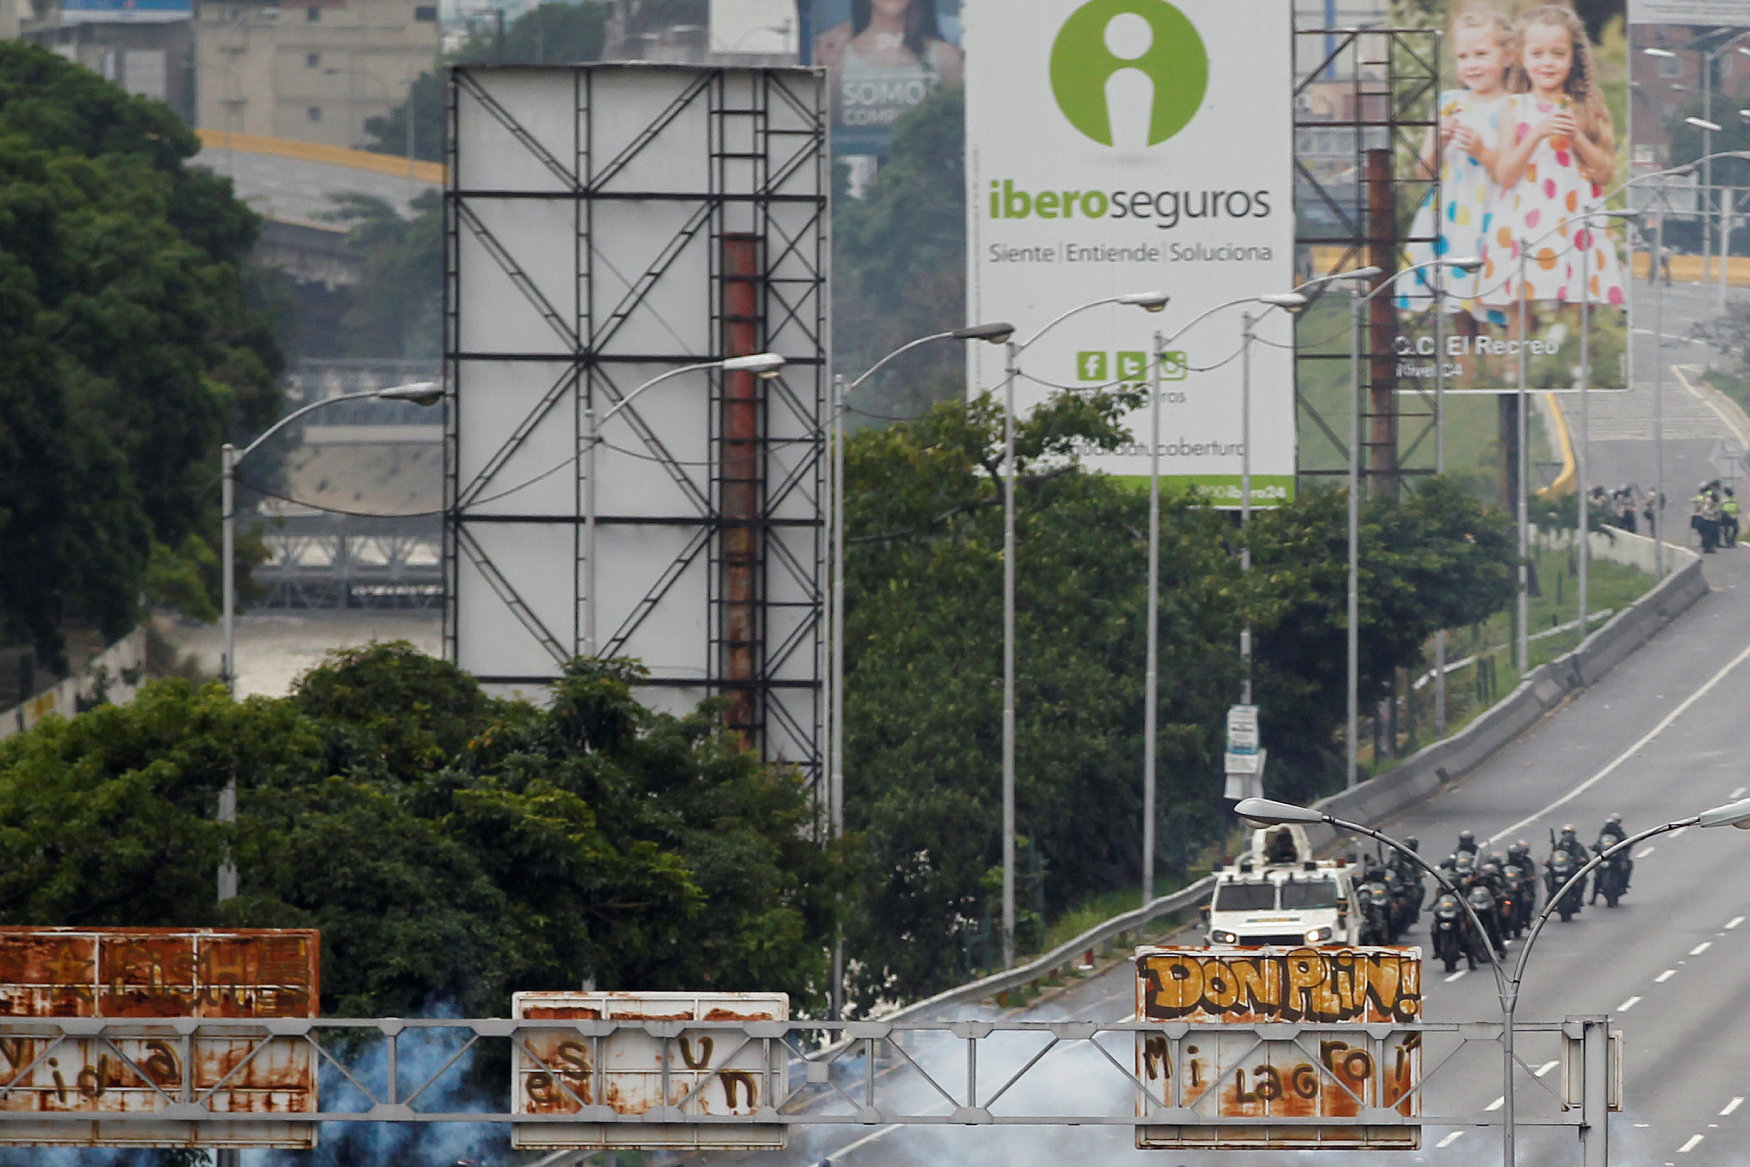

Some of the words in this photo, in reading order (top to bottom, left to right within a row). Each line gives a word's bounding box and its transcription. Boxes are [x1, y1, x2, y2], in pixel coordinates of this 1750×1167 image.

[842, 81, 934, 106] SOMO
[988, 178, 1272, 229] iberoseguros
[989, 243, 1055, 262] Siente
[1065, 243, 1160, 262] Entiende
[1169, 243, 1274, 262] Soluciona
[1446, 335, 1469, 356] El
[1474, 335, 1560, 355] Recreo
[1136, 953, 1282, 1018] DON
